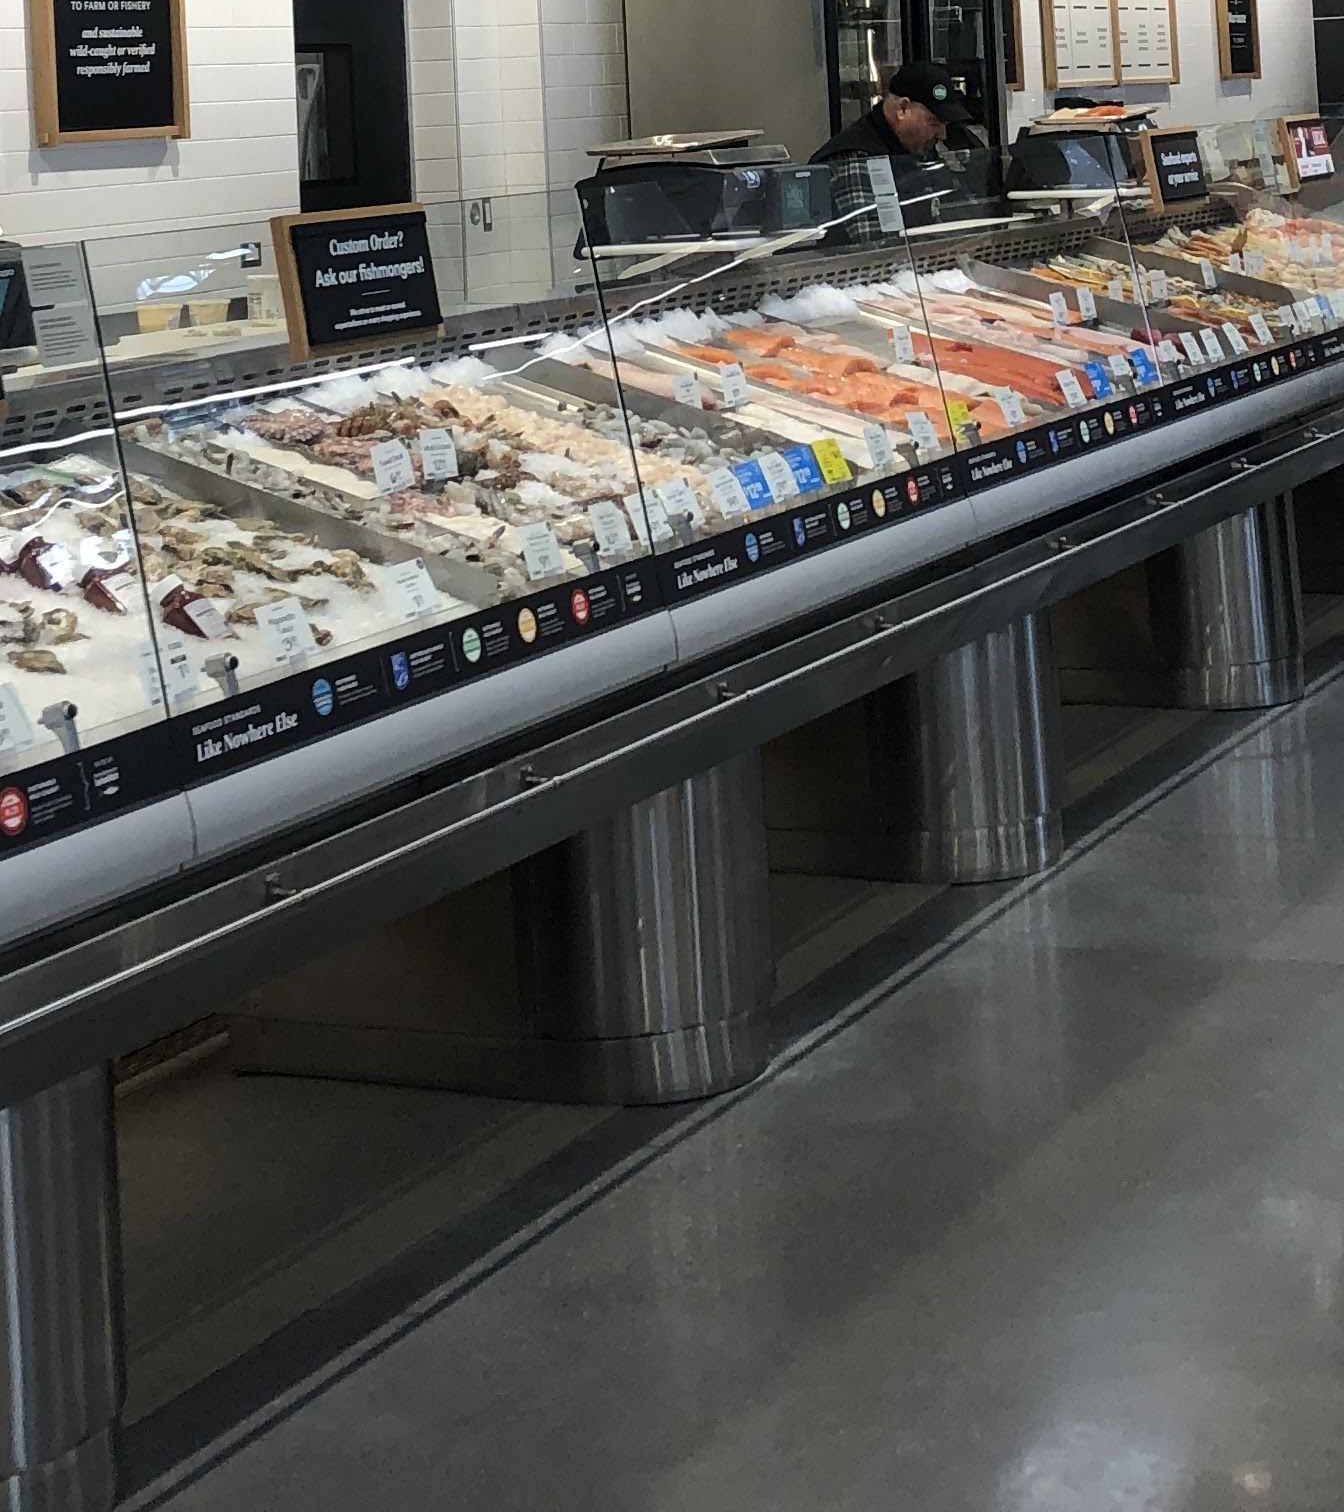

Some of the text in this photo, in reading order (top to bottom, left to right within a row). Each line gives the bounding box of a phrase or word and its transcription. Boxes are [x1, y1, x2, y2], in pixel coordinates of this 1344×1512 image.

[70, 0, 151, 10] TO FARM OR FISHERY
[329, 231, 404, 256] Custom Order?
[315, 256, 425, 287] Ask our fishmongers!
[196, 710, 299, 763] Like Nowhere Else
